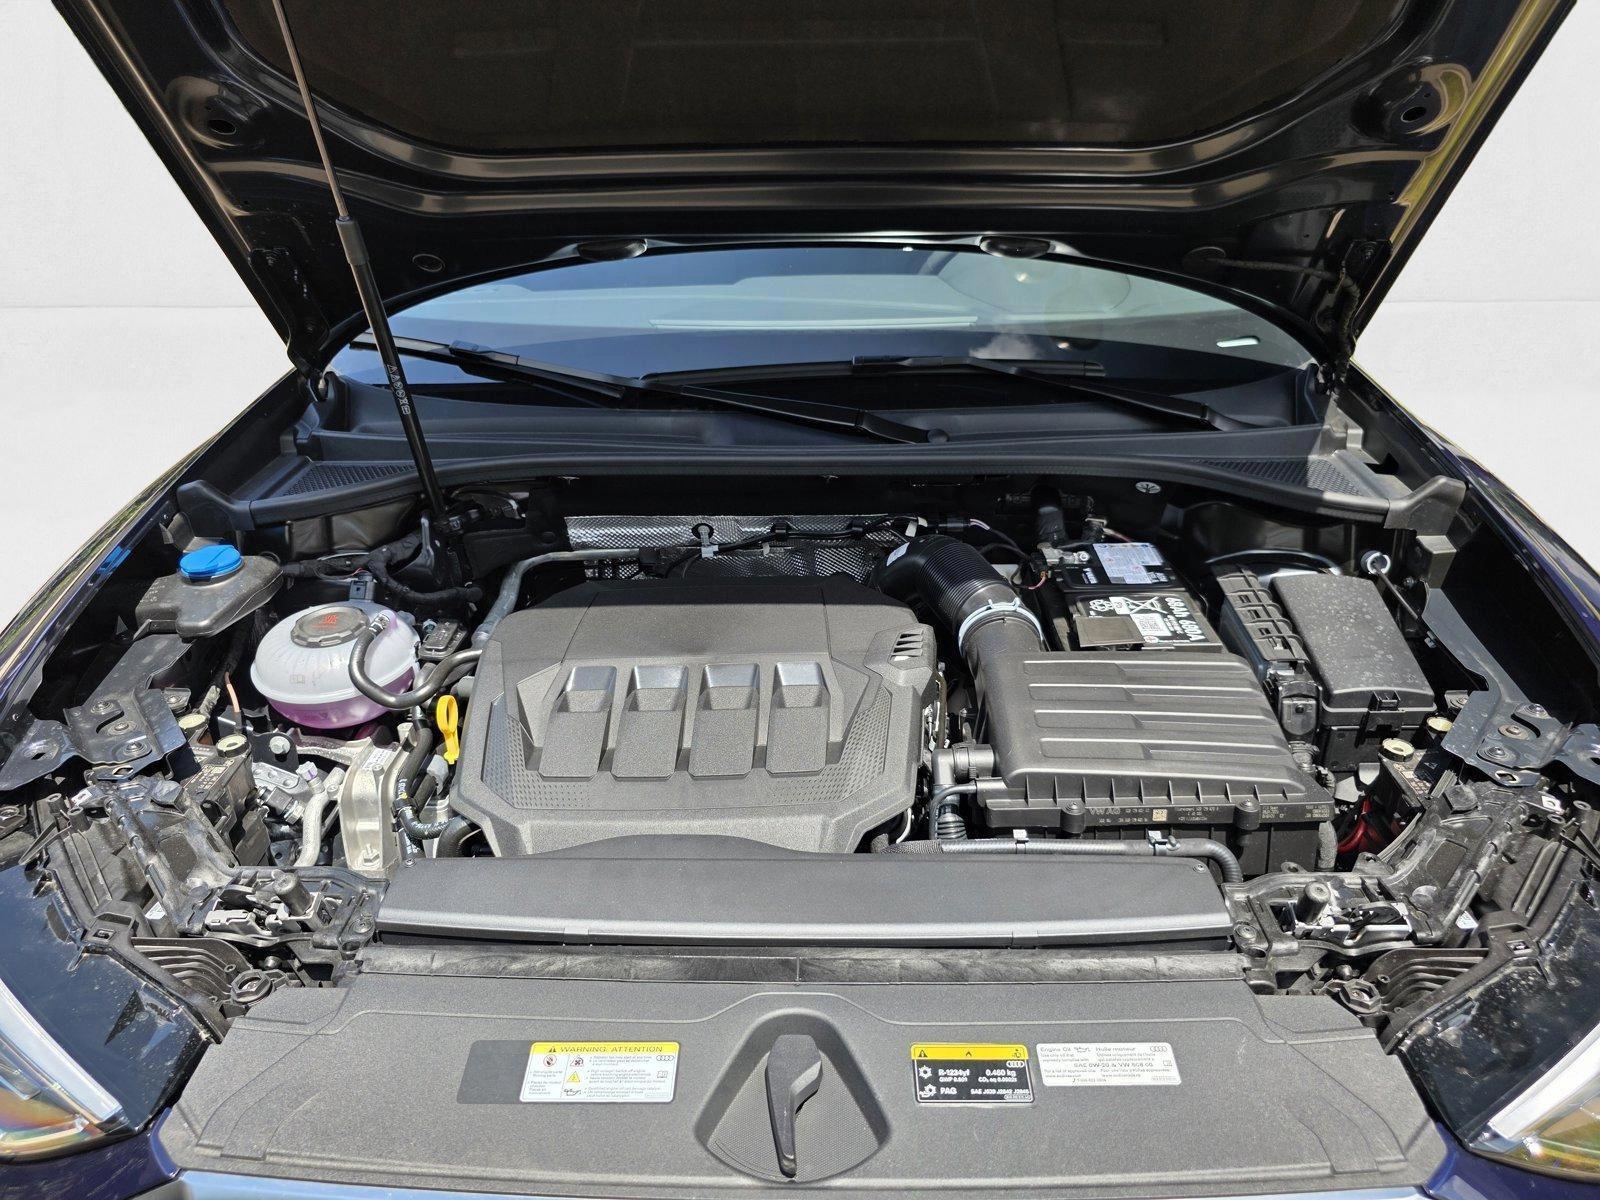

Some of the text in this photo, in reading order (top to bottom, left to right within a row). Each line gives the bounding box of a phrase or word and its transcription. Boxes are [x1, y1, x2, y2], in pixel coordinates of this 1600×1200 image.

[1179, 620, 1206, 640] 680A
[1006, 1068, 1017, 1078] kg
[940, 1086, 958, 1094] PAG
